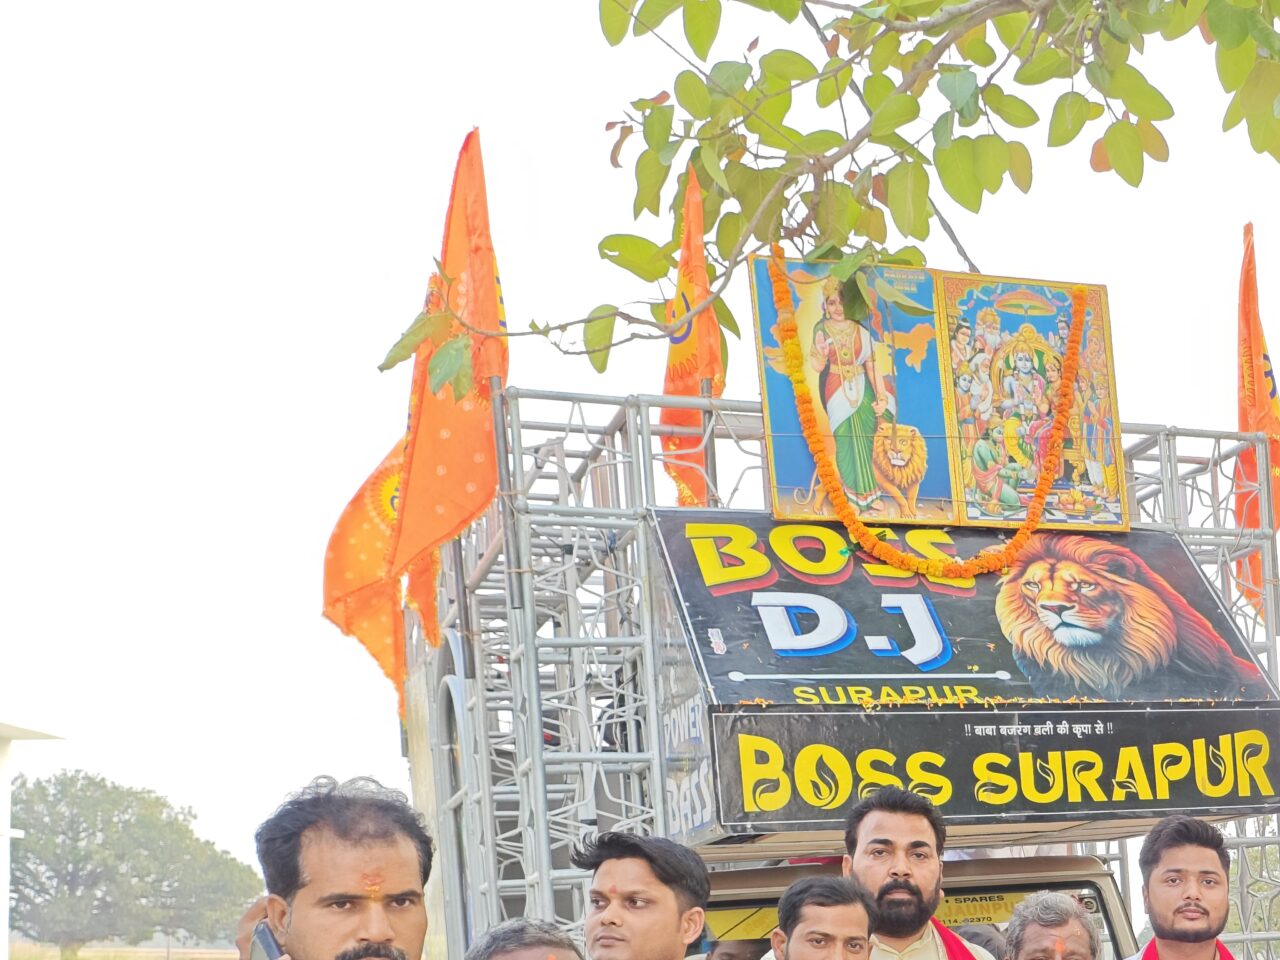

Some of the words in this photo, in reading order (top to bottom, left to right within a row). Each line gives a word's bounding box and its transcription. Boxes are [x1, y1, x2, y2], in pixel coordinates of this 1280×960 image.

[751, 592, 953, 671] D.J
[793, 685, 981, 705] SURAPUR
[663, 693, 705, 760] POWER
[974, 724, 997, 736] बाबा
[1000, 722, 1031, 736] बजरंग
[1033, 721, 1054, 736] बली
[1056, 720, 1070, 735] की
[1072, 723, 1092, 738] कृपा
[1094, 720, 1104, 735] से
[738, 733, 953, 812] BOSS
[972, 729, 1275, 804] SURAPUR
[666, 758, 712, 837] BASS
[944, 902, 1015, 917] JAUNPU
[954, 895, 1005, 904] SPARES
